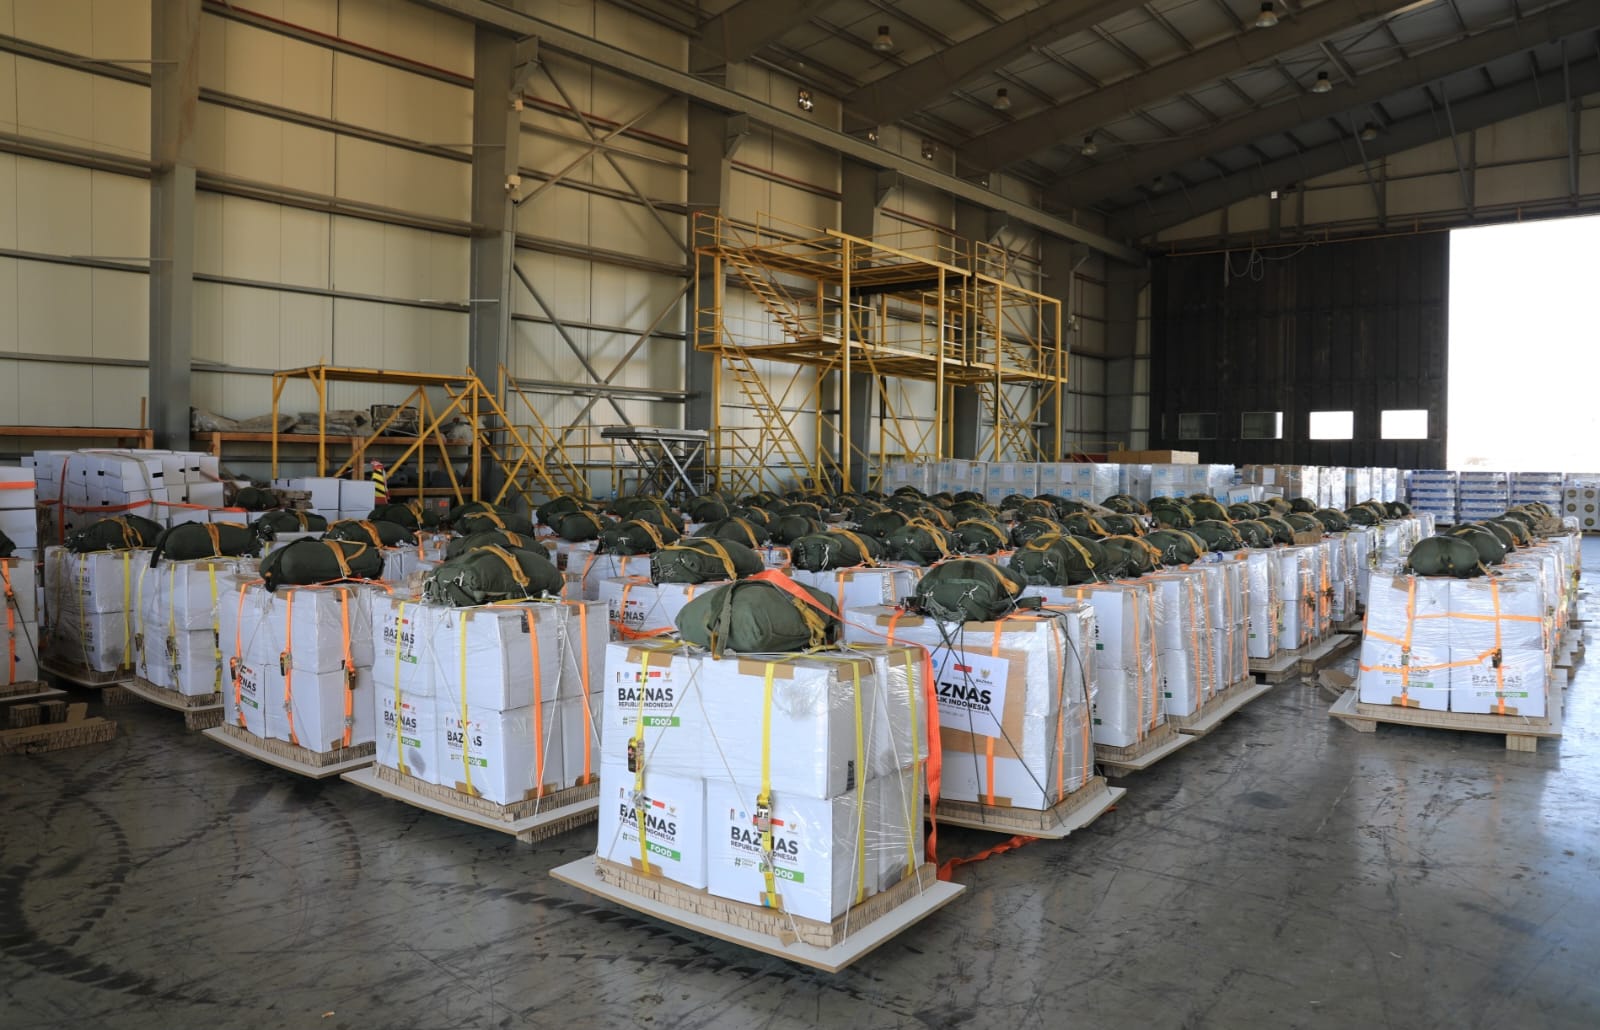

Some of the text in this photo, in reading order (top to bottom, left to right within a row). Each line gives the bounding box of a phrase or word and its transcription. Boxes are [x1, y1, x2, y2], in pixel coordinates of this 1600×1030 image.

[609, 610, 644, 621] BANAS
[933, 679, 992, 705] ZNAS
[948, 699, 990, 712] INDONESIA
[650, 718, 672, 726] FOOD
[620, 803, 677, 836] BANAS
[645, 826, 675, 843] NDONESIA
[650, 843, 672, 857] FOOD
[774, 868, 794, 879] OOD
